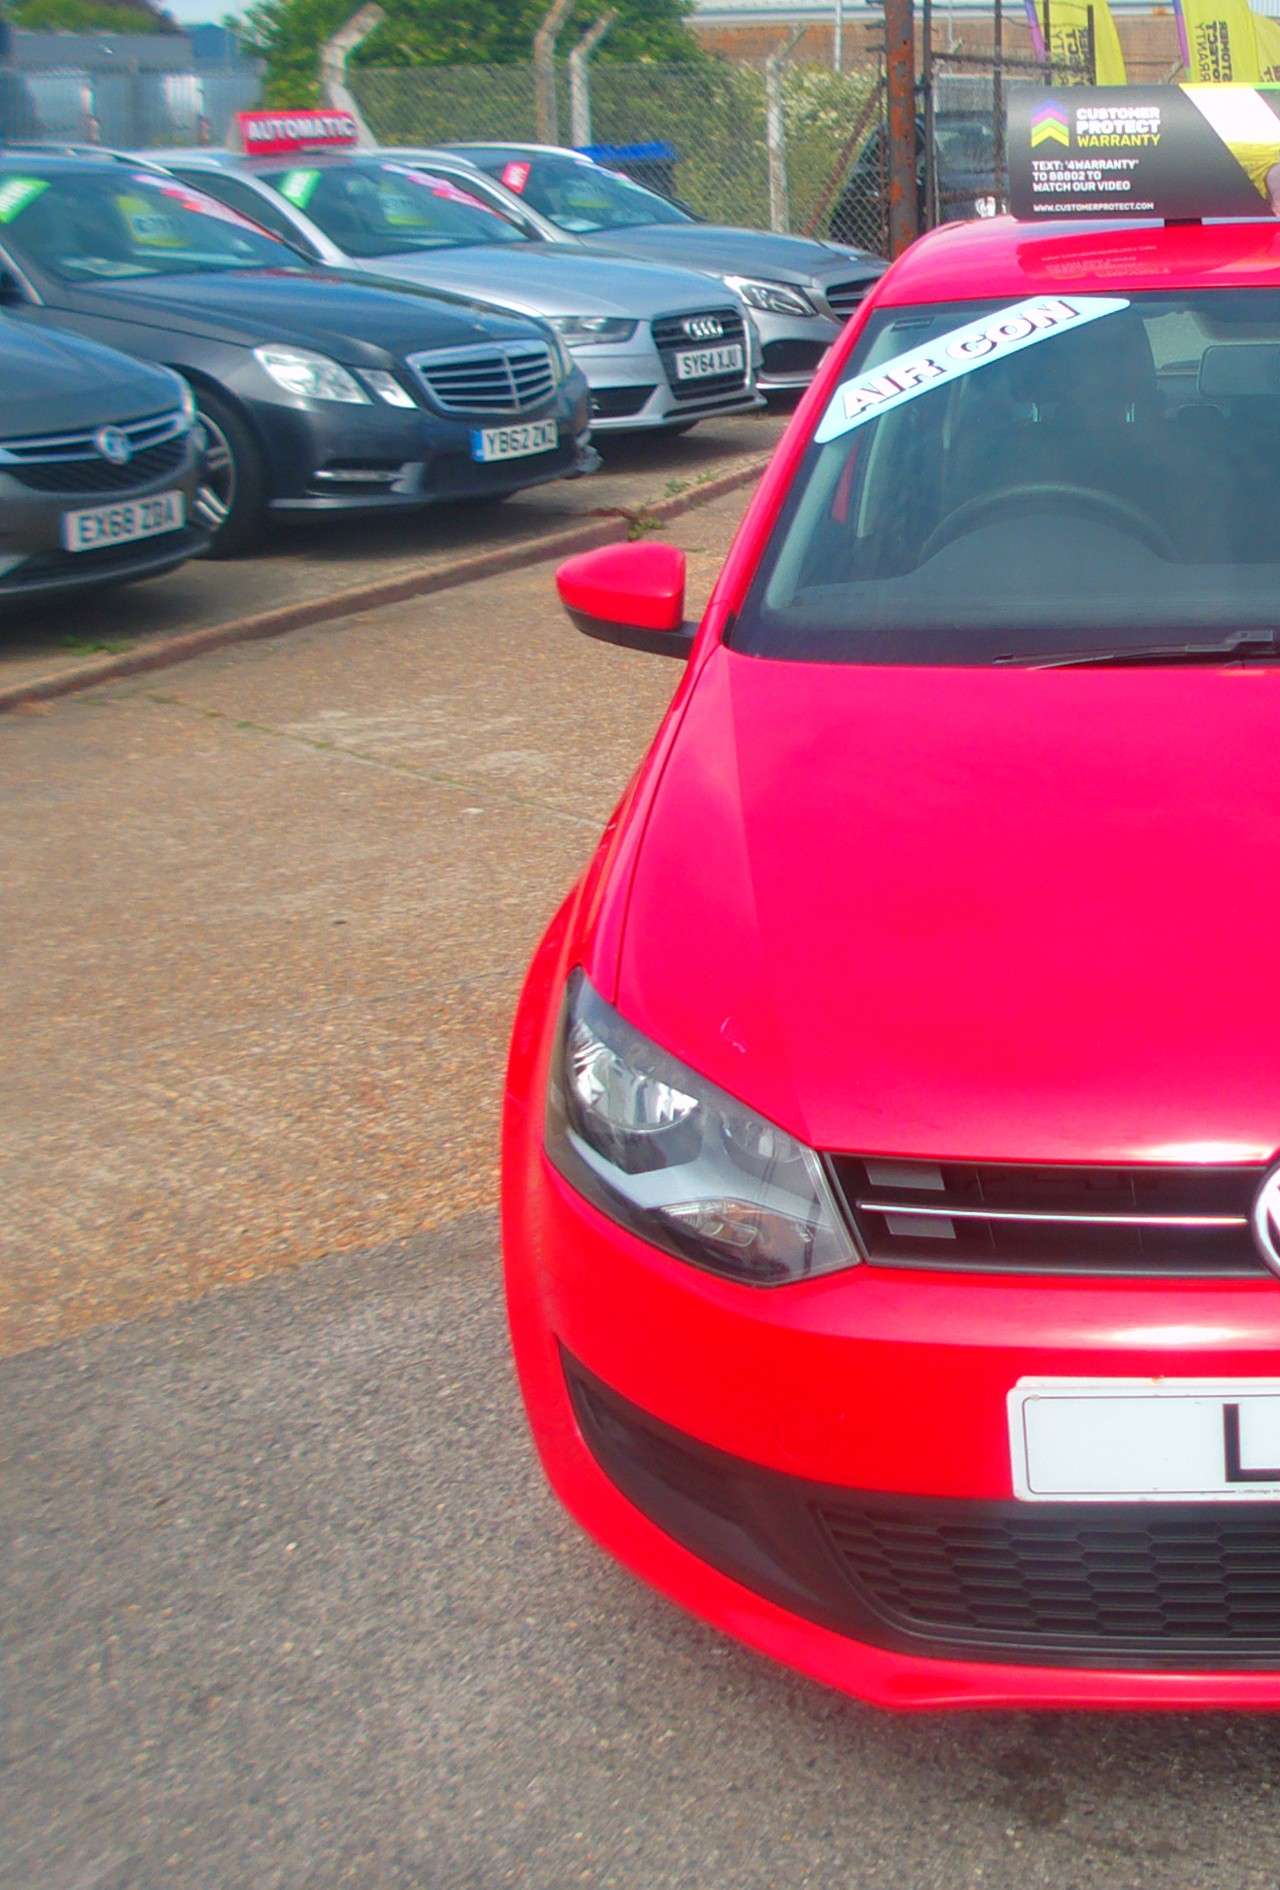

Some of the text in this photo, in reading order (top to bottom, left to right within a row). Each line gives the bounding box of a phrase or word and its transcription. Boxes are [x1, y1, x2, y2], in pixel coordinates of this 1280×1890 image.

[1076, 107, 1160, 120] CUSTOMER
[248, 117, 357, 141] AUTOMATIC
[1076, 120, 1161, 134] PROTECT
[1077, 134, 1160, 147] WARRANTY
[1032, 161, 1064, 171] TEXT:
[1032, 172, 1047, 181] TO
[1087, 171, 1102, 180] TO
[1033, 181, 1131, 192] WATCH OUR VIDEO
[683, 352, 715, 375] SY64
[843, 300, 1081, 420] AIR CON
[486, 427, 529, 454] YB62
[78, 507, 134, 543] EX68
